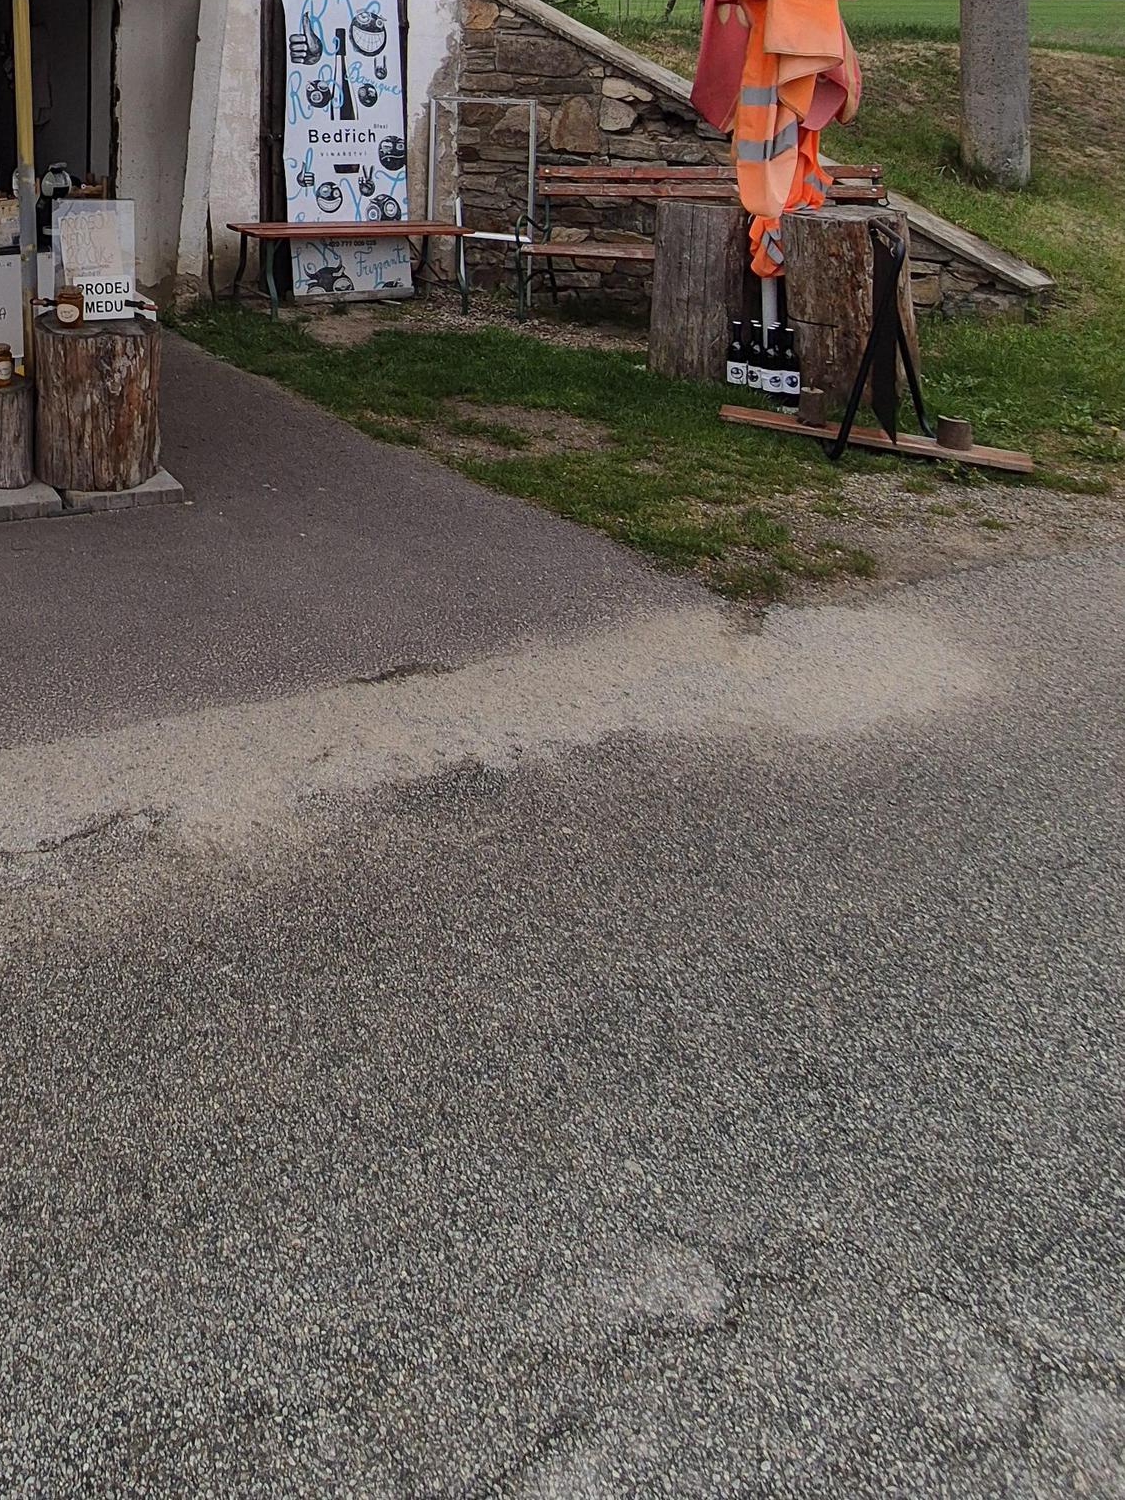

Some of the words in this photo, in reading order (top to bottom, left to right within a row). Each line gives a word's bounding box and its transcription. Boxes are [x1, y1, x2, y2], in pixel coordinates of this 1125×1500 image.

[308, 128, 376, 144] Bedřich
[77, 282, 130, 296] PRODEJ
[85, 300, 123, 314] MEDU
